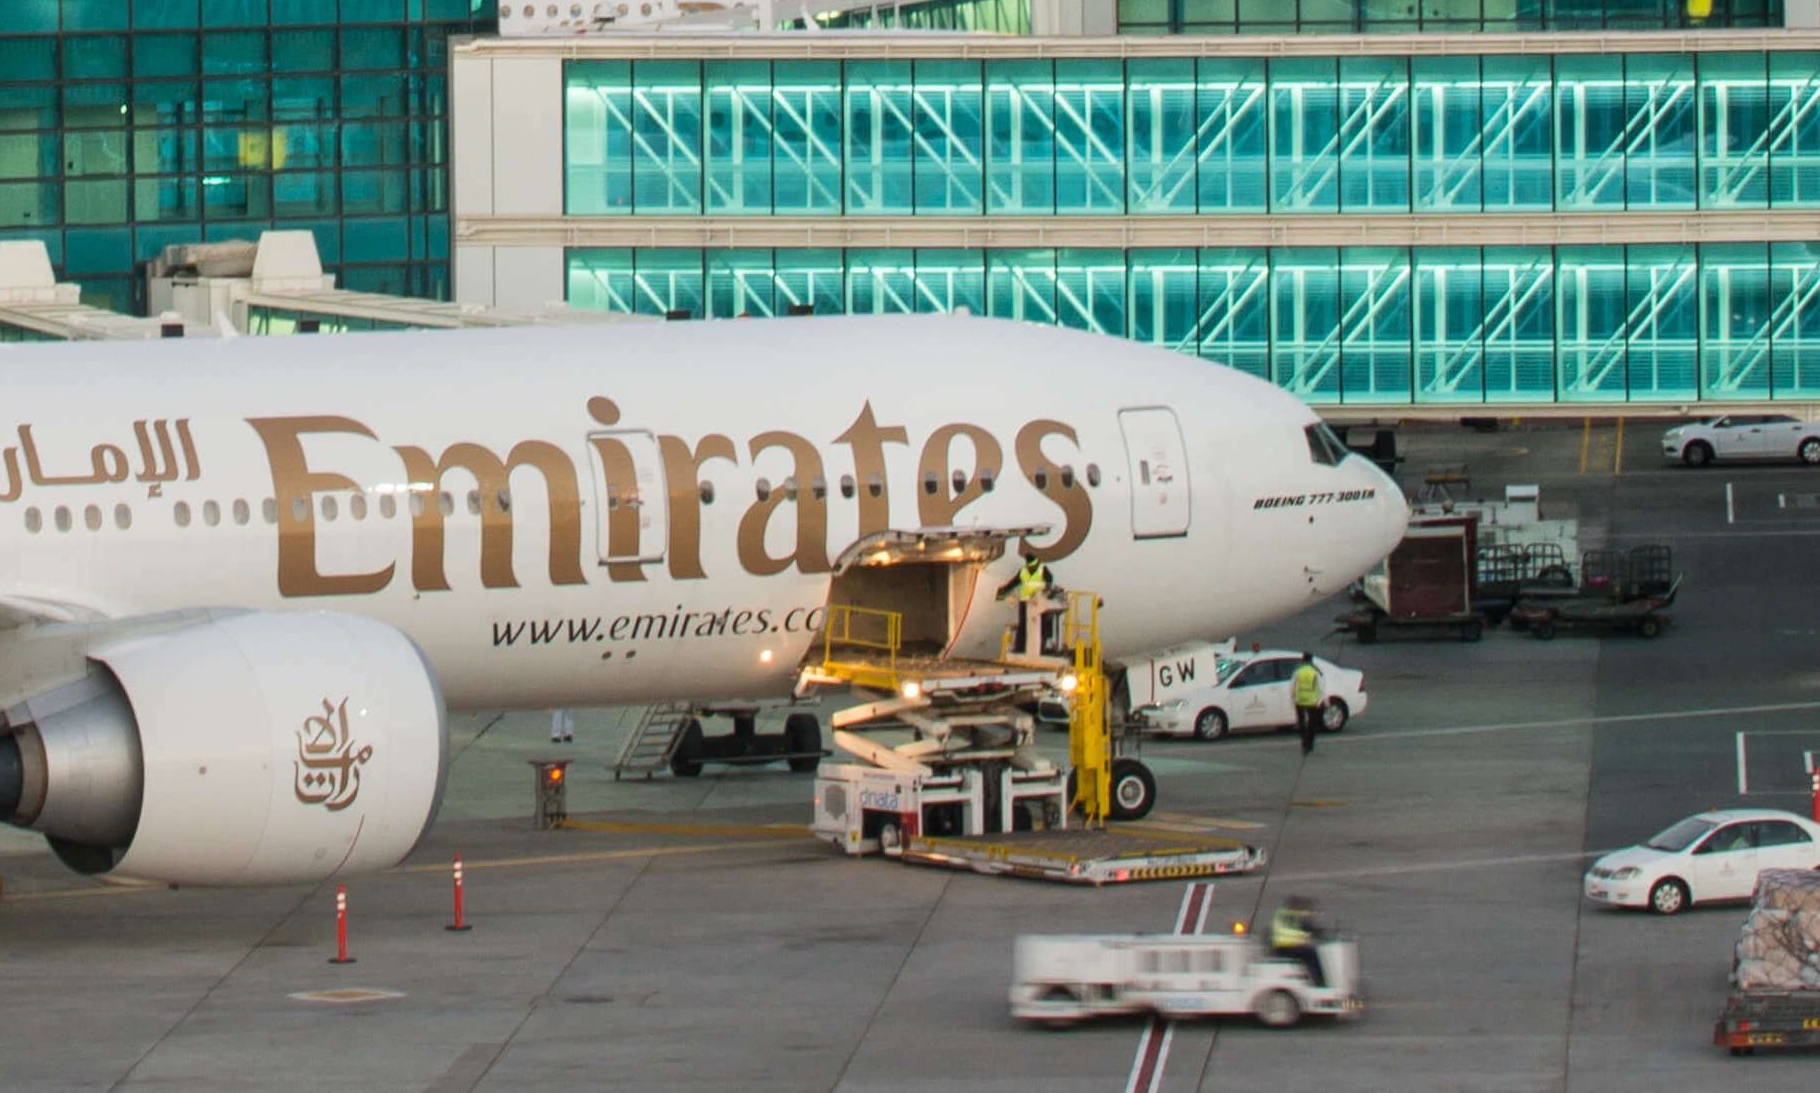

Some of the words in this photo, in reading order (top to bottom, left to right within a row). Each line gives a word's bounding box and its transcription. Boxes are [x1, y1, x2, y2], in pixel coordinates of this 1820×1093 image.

[244, 395, 1094, 598] Emirates
[1253, 494, 1306, 511] BOEING
[492, 604, 826, 647] www.emirates.co
